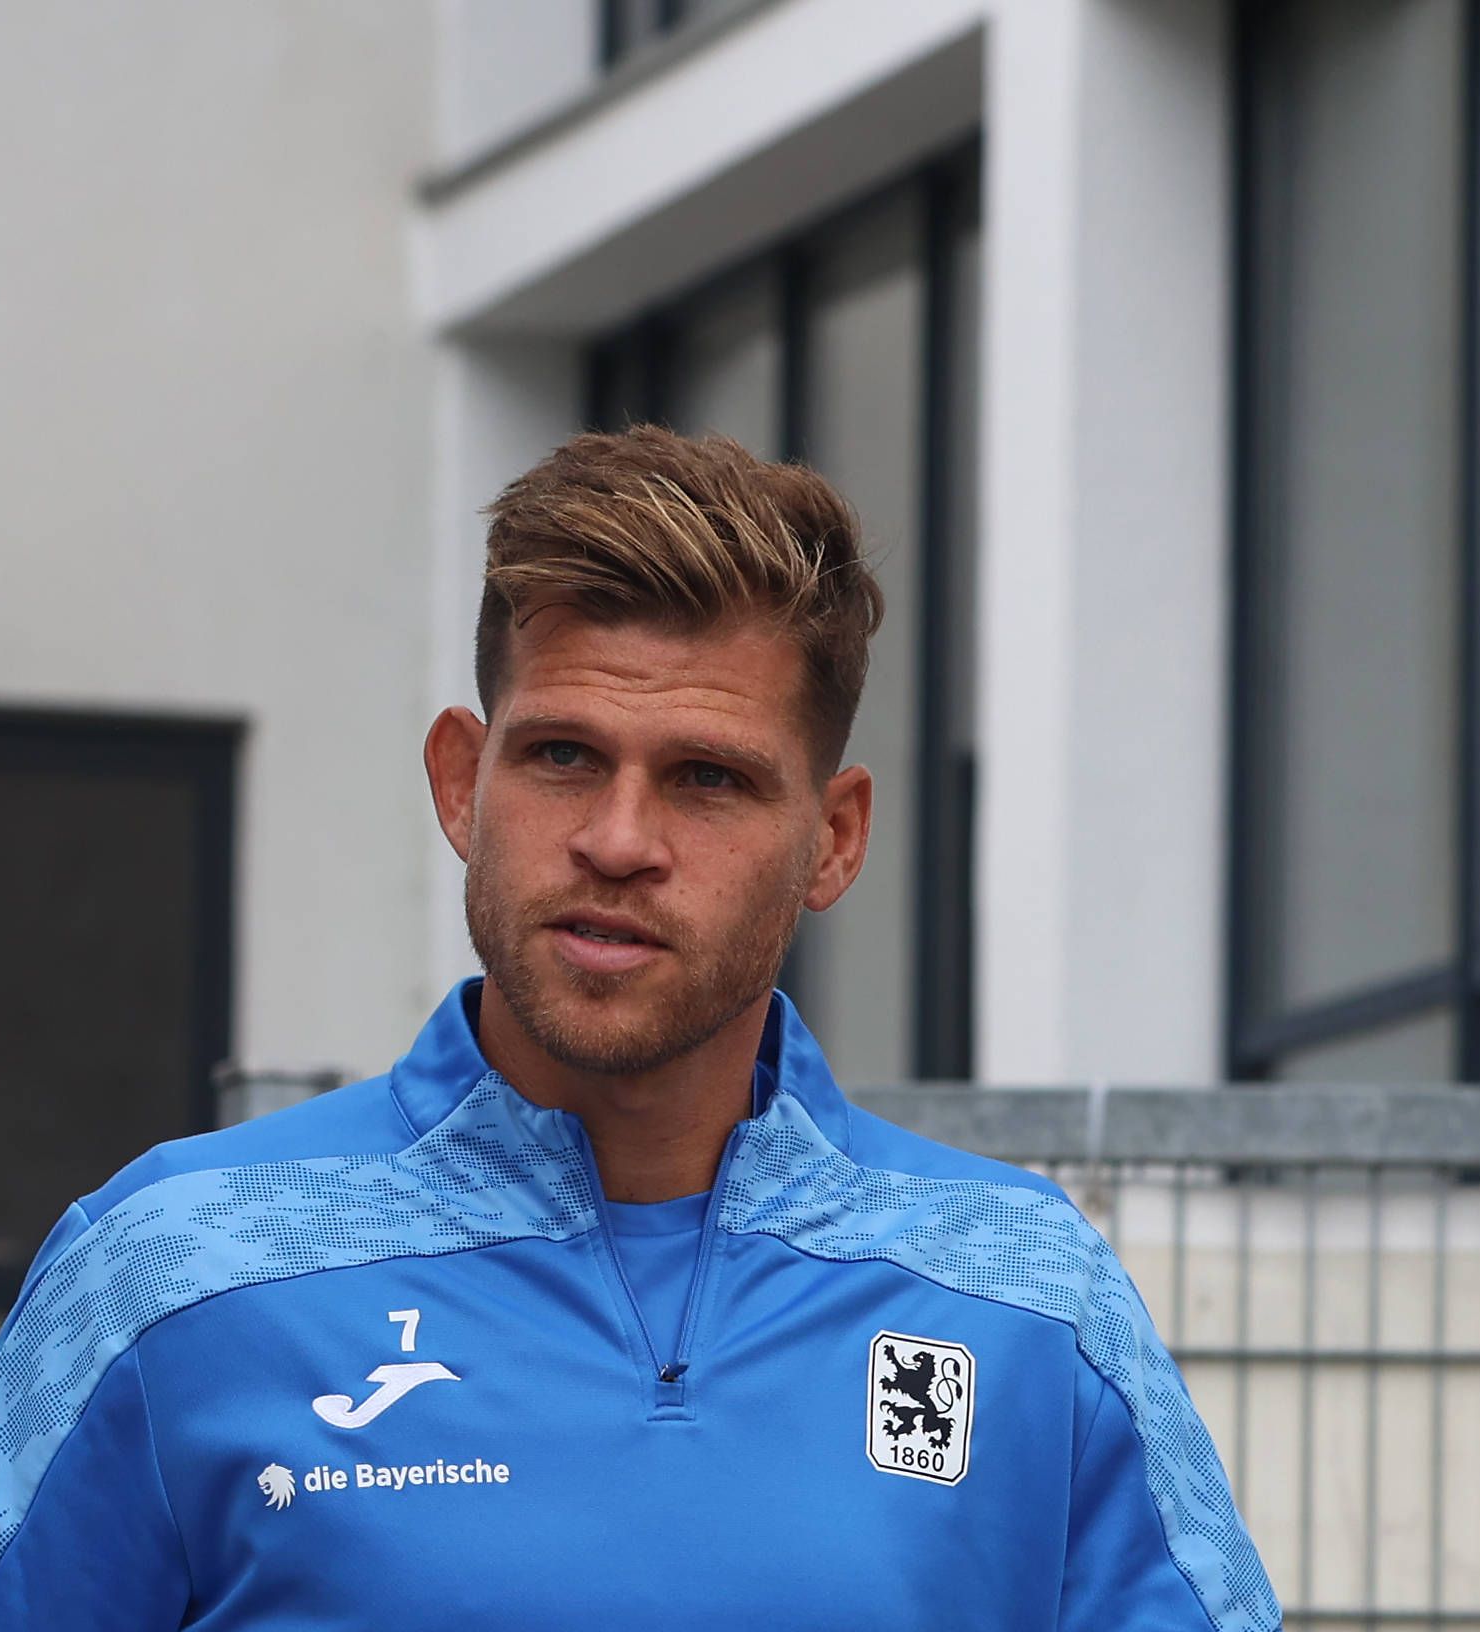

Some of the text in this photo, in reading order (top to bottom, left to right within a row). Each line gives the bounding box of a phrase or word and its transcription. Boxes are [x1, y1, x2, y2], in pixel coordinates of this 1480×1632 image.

[388, 1309, 420, 1352] 7
[304, 1459, 510, 1491] die Bayerische
[890, 1445, 945, 1473] 1860
